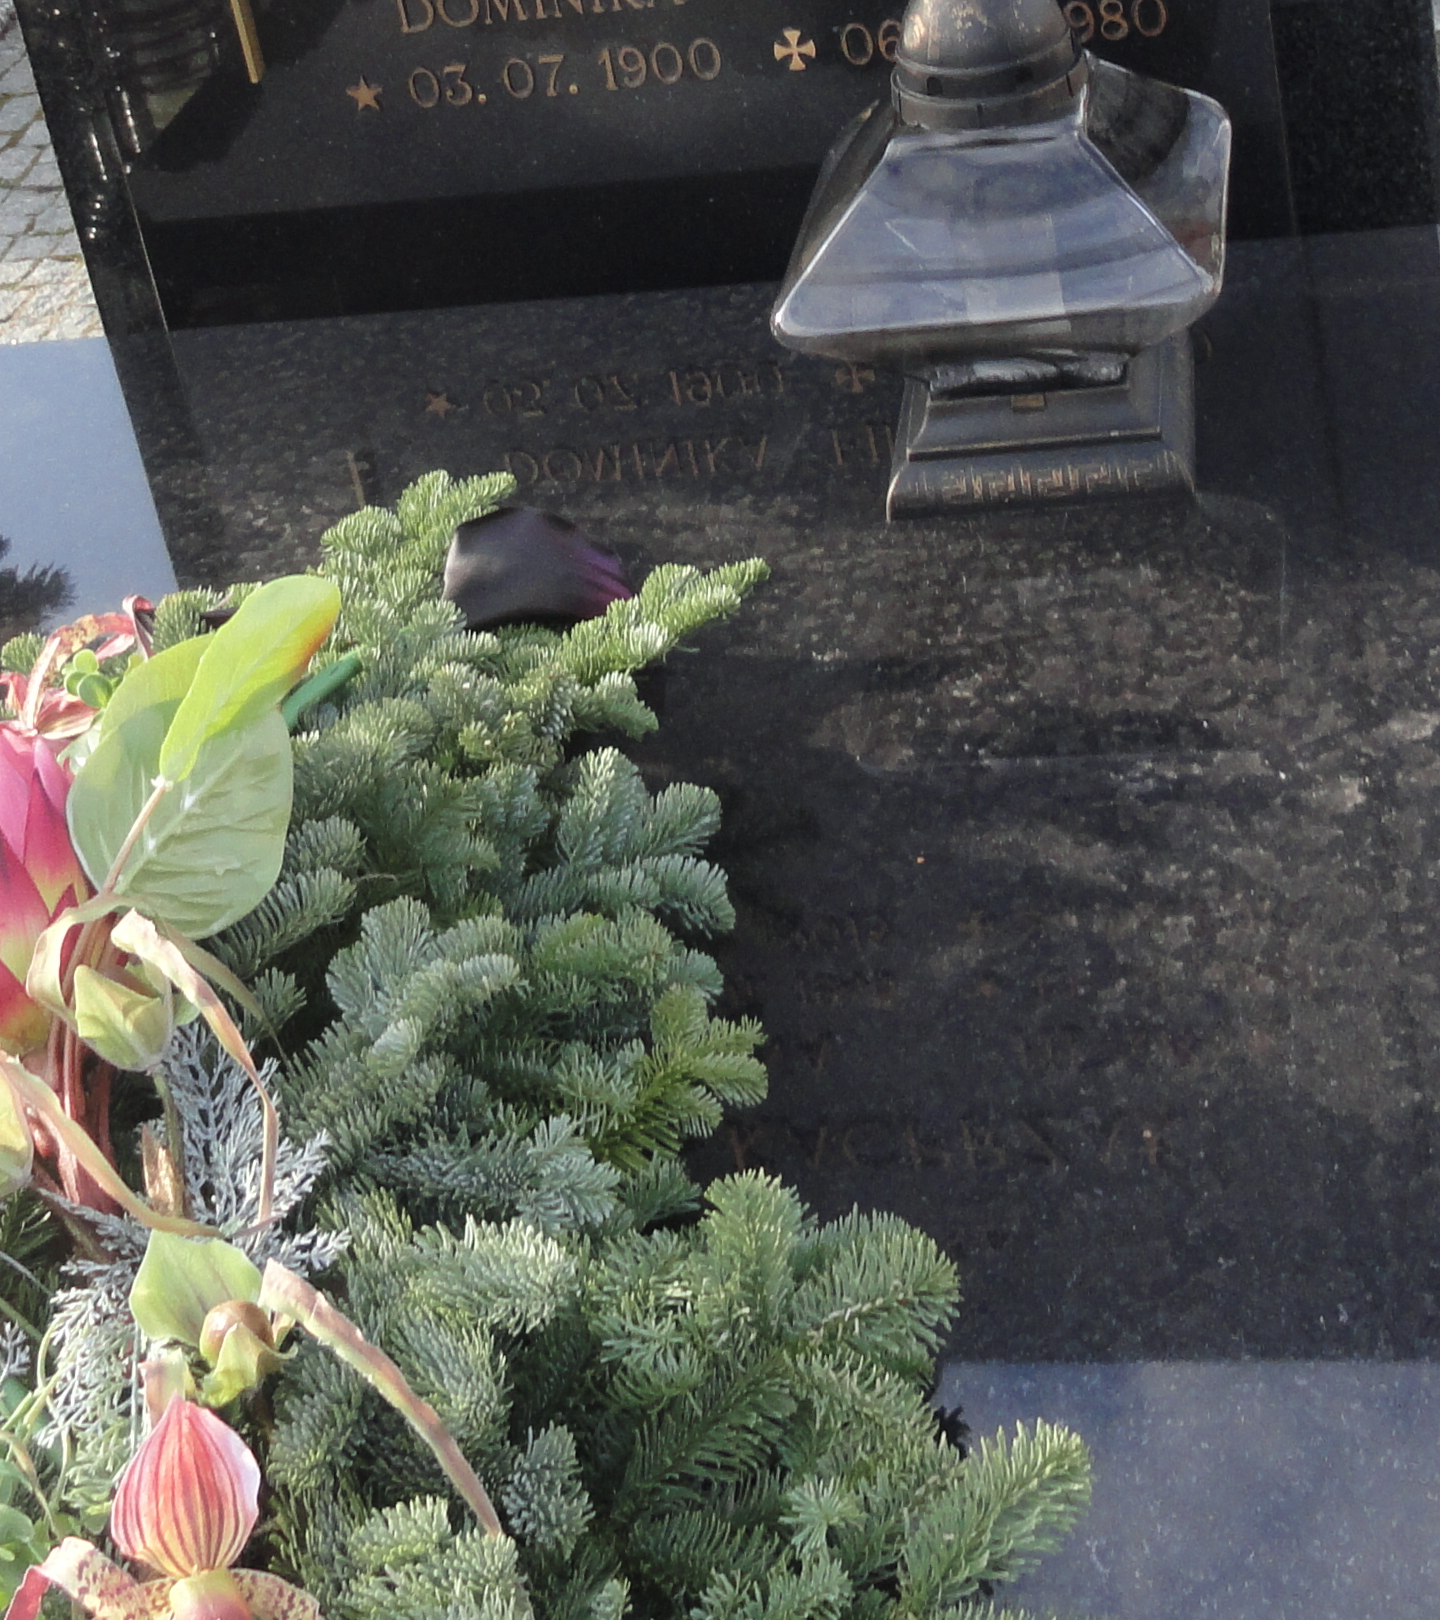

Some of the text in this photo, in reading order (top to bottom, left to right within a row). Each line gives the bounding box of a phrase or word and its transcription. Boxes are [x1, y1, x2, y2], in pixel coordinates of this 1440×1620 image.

[408, 64, 487, 109] 03.
[502, 56, 581, 100] 07.
[597, 37, 722, 92] 1900
